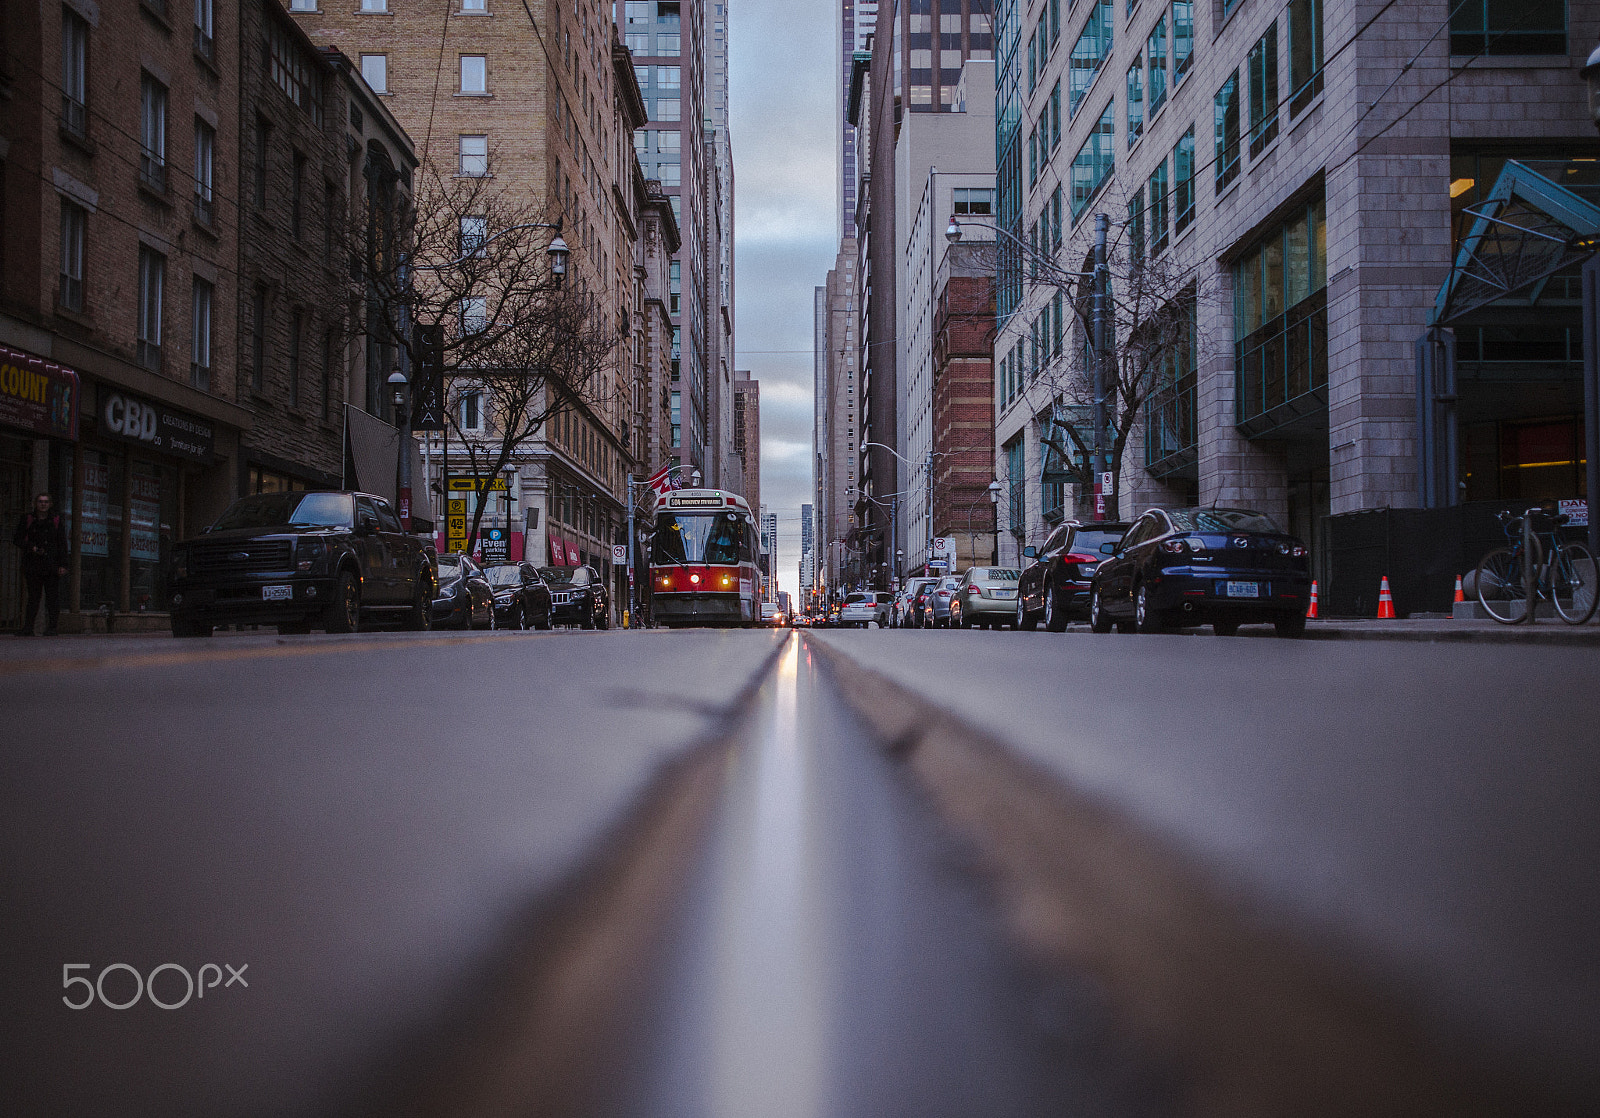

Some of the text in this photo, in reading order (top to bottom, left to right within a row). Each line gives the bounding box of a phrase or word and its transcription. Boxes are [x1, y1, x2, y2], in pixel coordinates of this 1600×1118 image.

[0, 364, 48, 403] COUNT
[105, 395, 157, 440] CBD
[84, 468, 107, 489] LEASE
